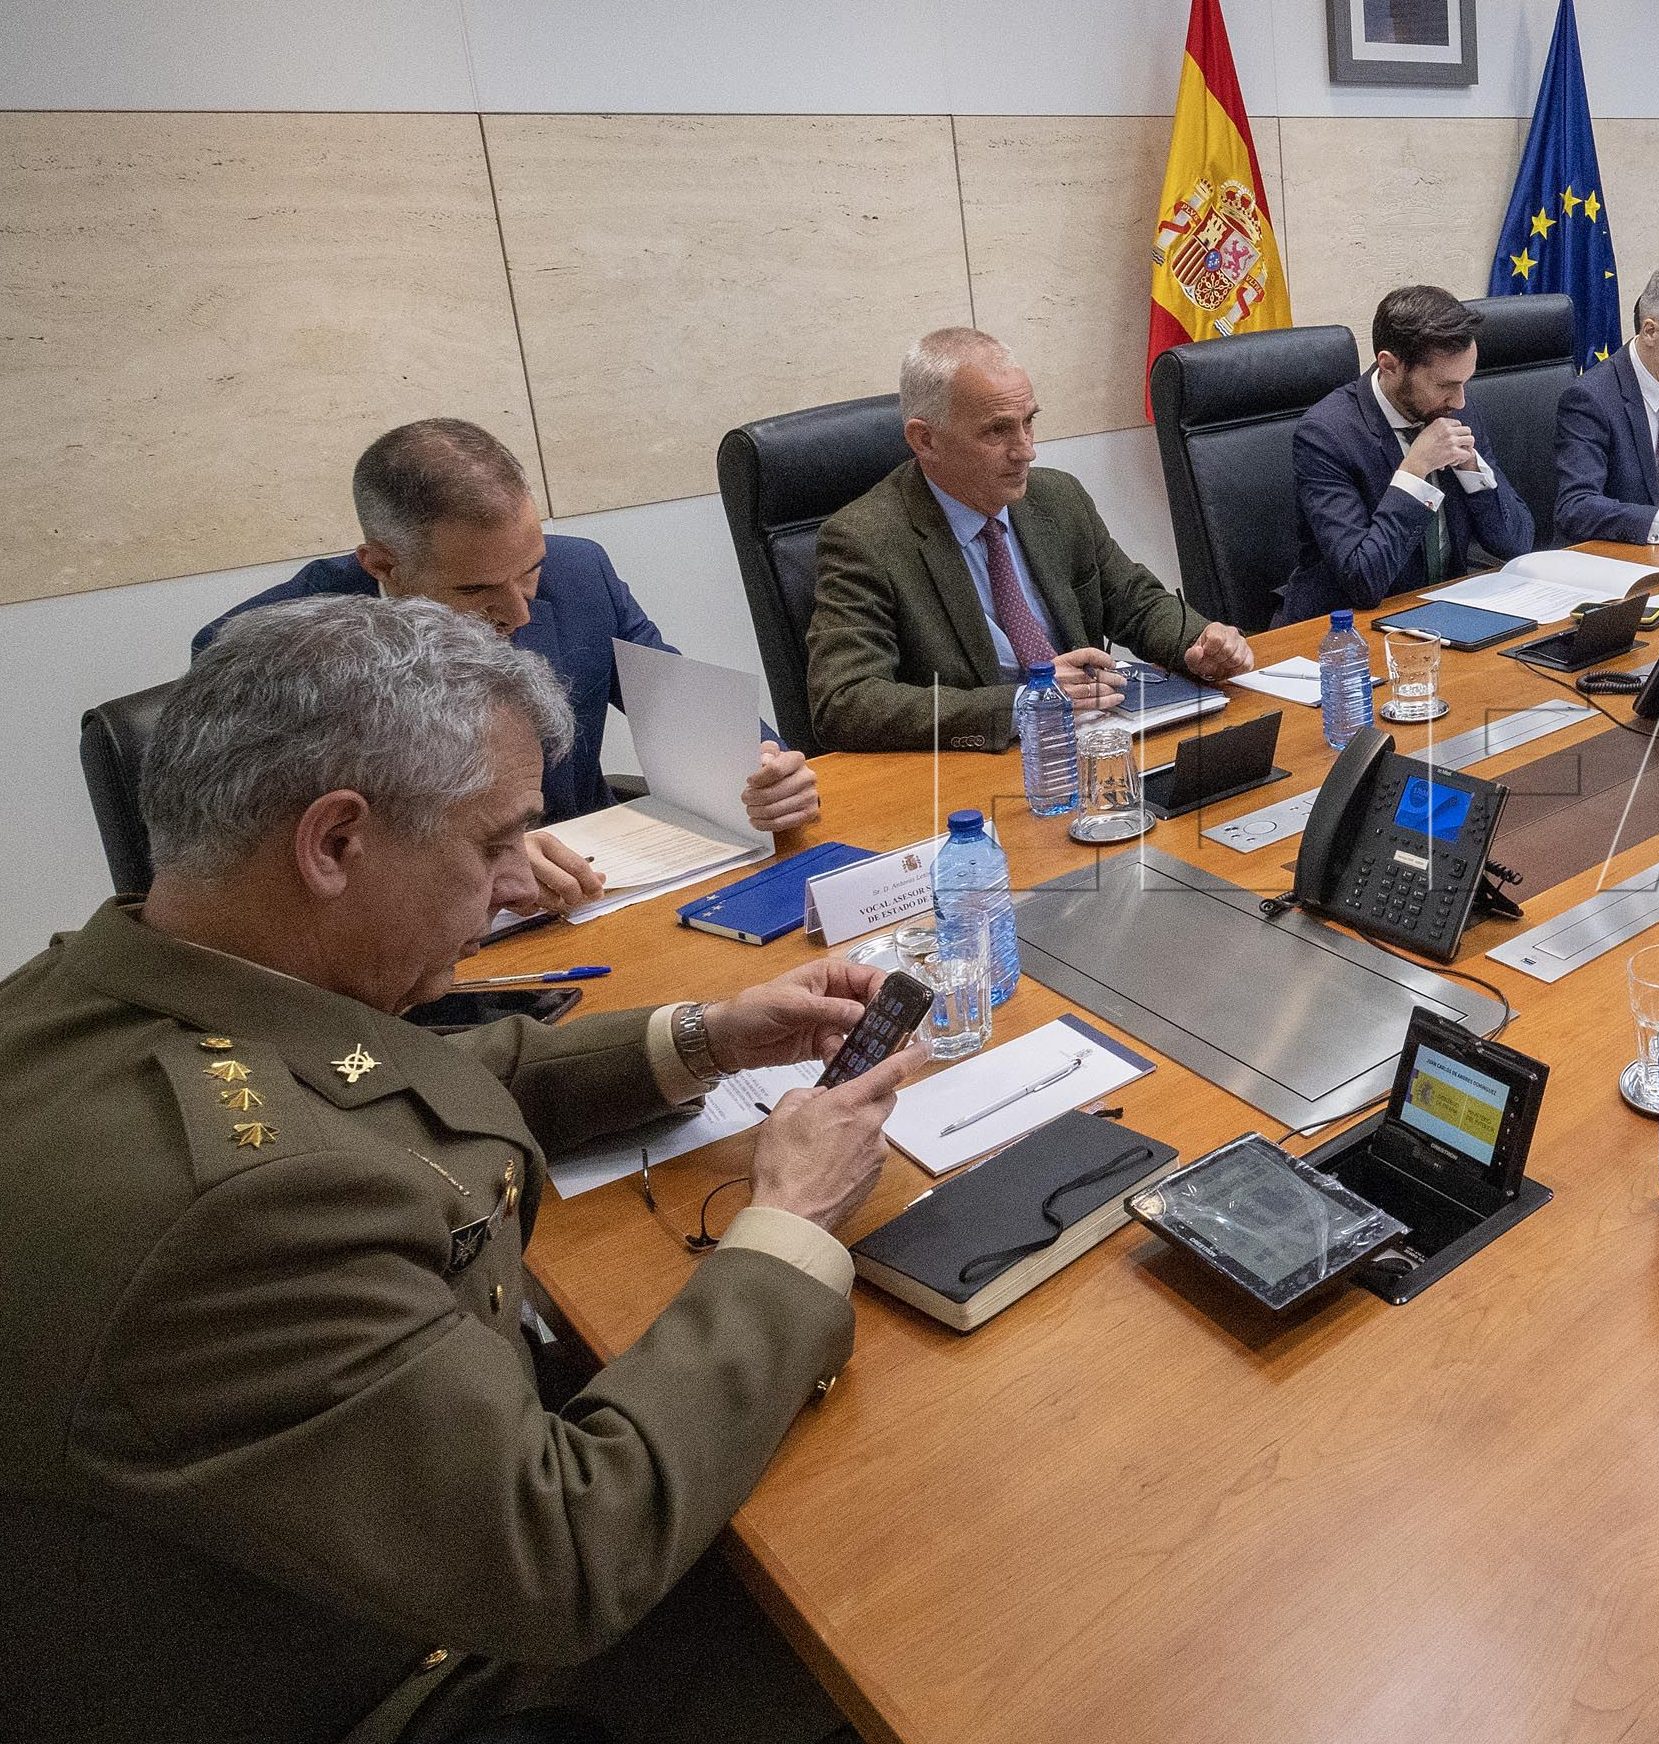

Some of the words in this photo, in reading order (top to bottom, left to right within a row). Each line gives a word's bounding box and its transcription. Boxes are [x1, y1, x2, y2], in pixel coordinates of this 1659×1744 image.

[859, 900, 892, 915] VOCAL
[892, 887, 926, 905] ASESOR
[867, 914, 880, 923] DE
[881, 900, 916, 918] ESTADO
[917, 895, 928, 906] DE
